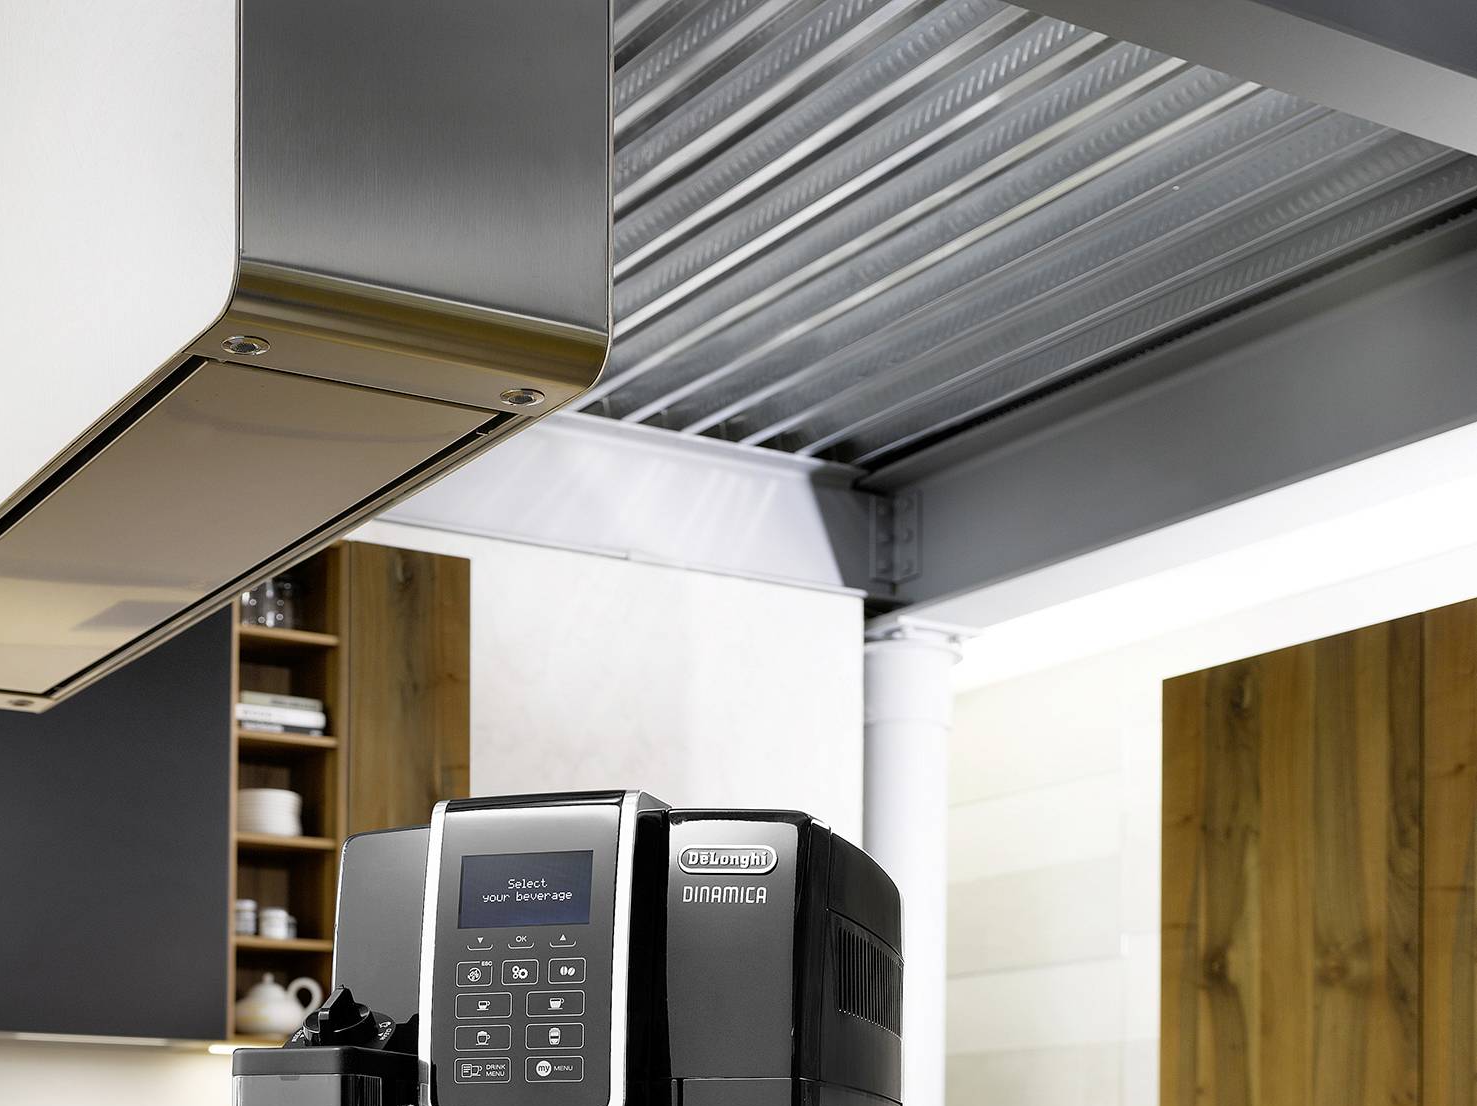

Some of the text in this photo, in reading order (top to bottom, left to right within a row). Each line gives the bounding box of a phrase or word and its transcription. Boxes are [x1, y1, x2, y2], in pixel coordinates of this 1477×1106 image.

[507, 878, 547, 889] Select
[482, 891, 573, 903] your beverage
[683, 886, 767, 904] DINAMICA
[515, 935, 527, 943] OK
